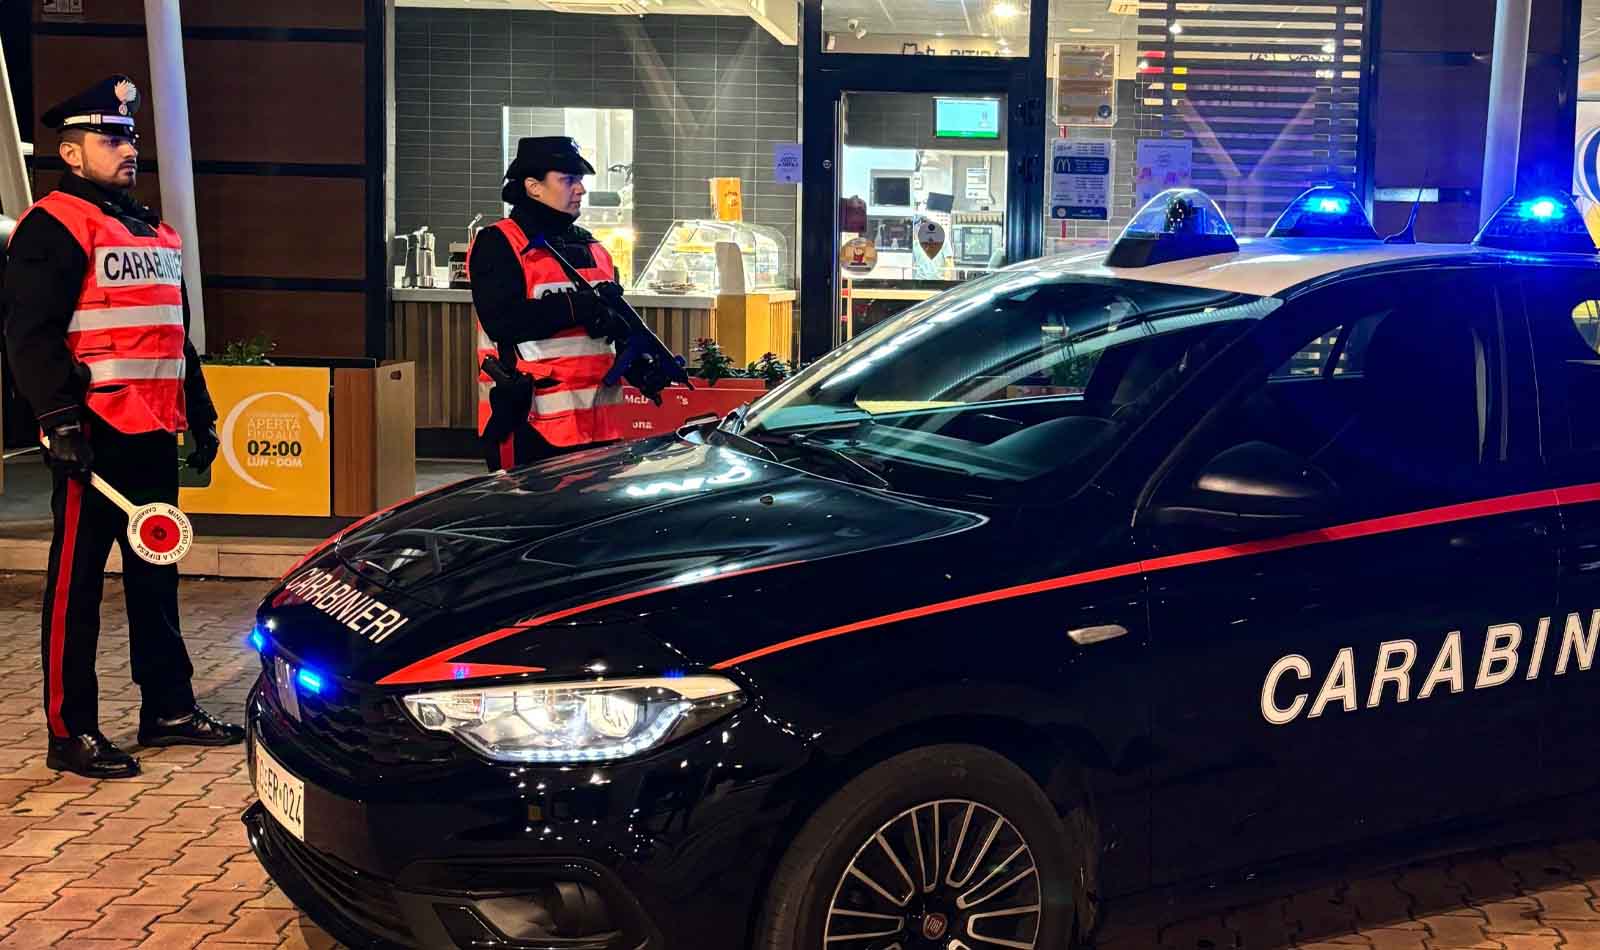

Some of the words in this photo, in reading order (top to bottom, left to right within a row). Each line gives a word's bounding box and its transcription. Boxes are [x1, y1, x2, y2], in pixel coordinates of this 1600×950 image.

[248, 440, 302, 456] 02:00
[167, 509, 188, 544] MINISTERO
[285, 567, 409, 644] CARABINIERI
[1261, 608, 1600, 725] CARABIN
